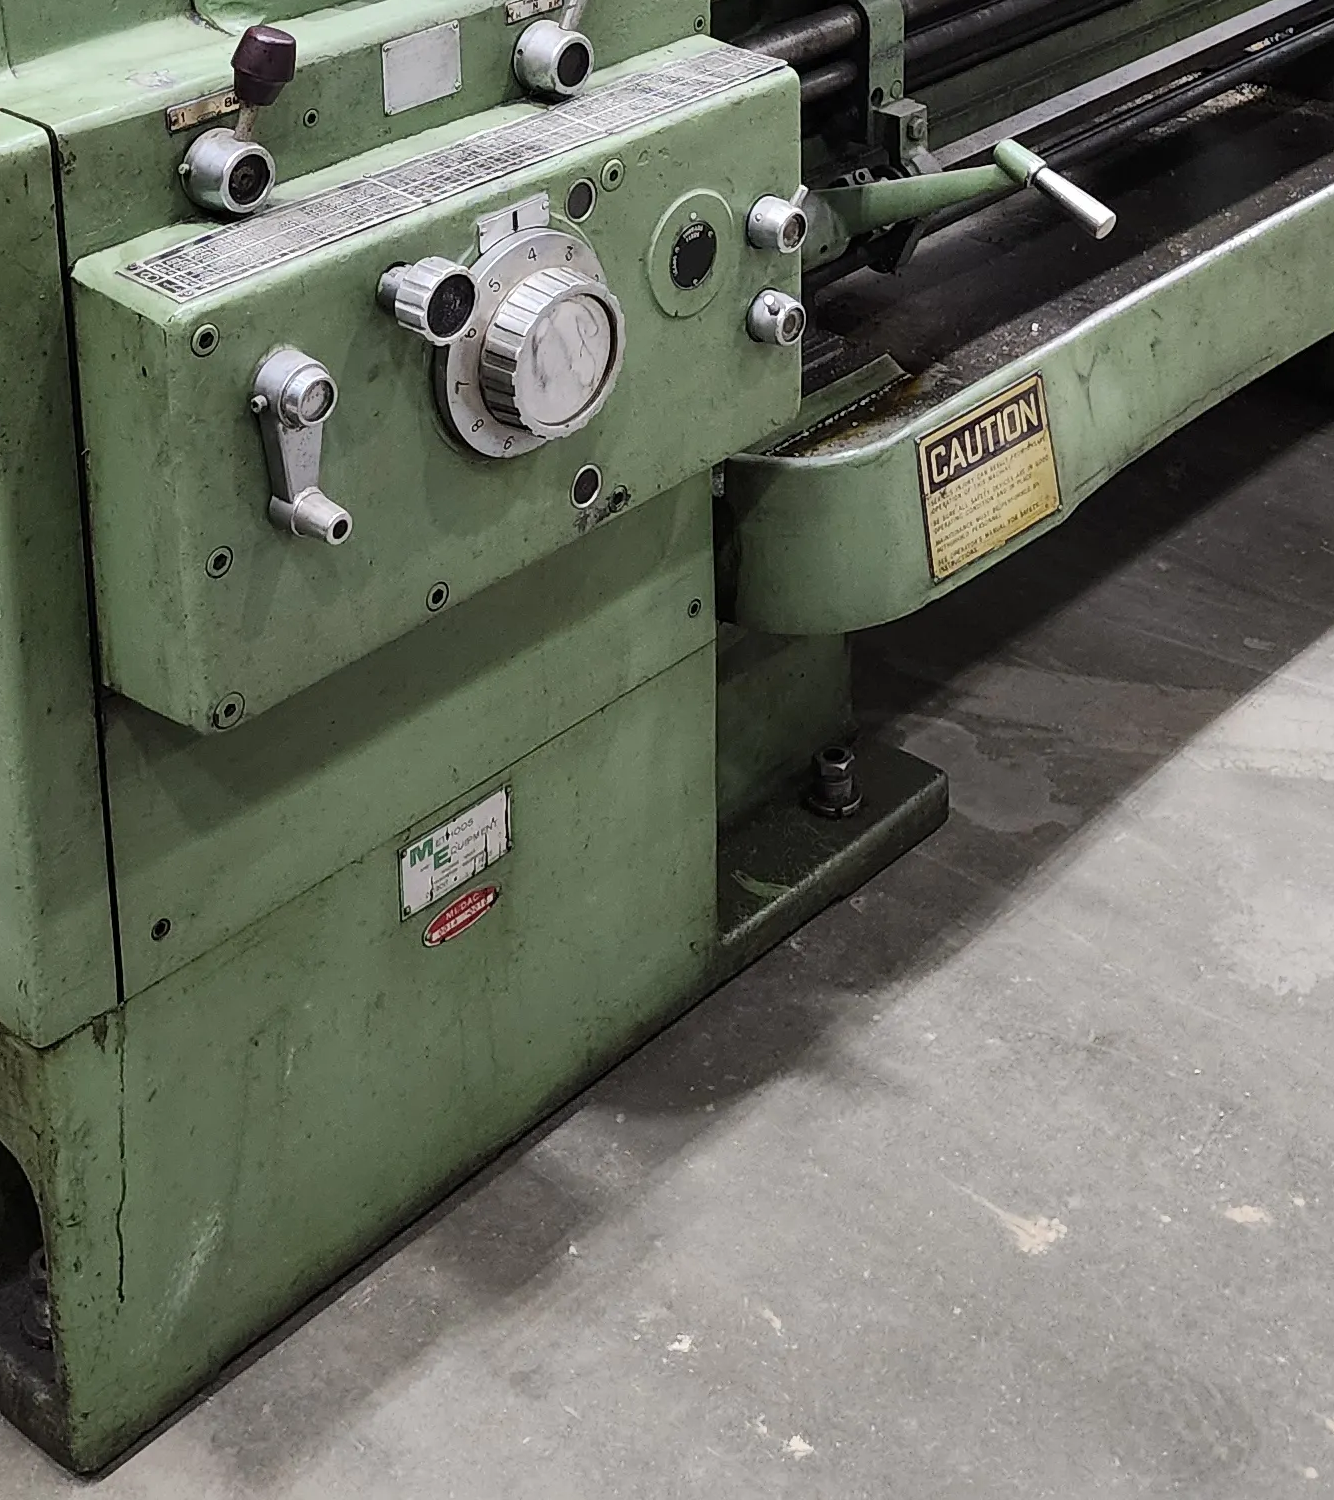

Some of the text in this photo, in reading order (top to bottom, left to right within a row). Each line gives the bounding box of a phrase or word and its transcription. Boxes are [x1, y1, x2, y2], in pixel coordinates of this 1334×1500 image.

[527, 247, 537, 261] 4
[488, 278, 501, 293] 5
[455, 381, 470, 394] 7
[471, 419, 484, 432] 8
[930, 392, 1038, 484] CAUTION
